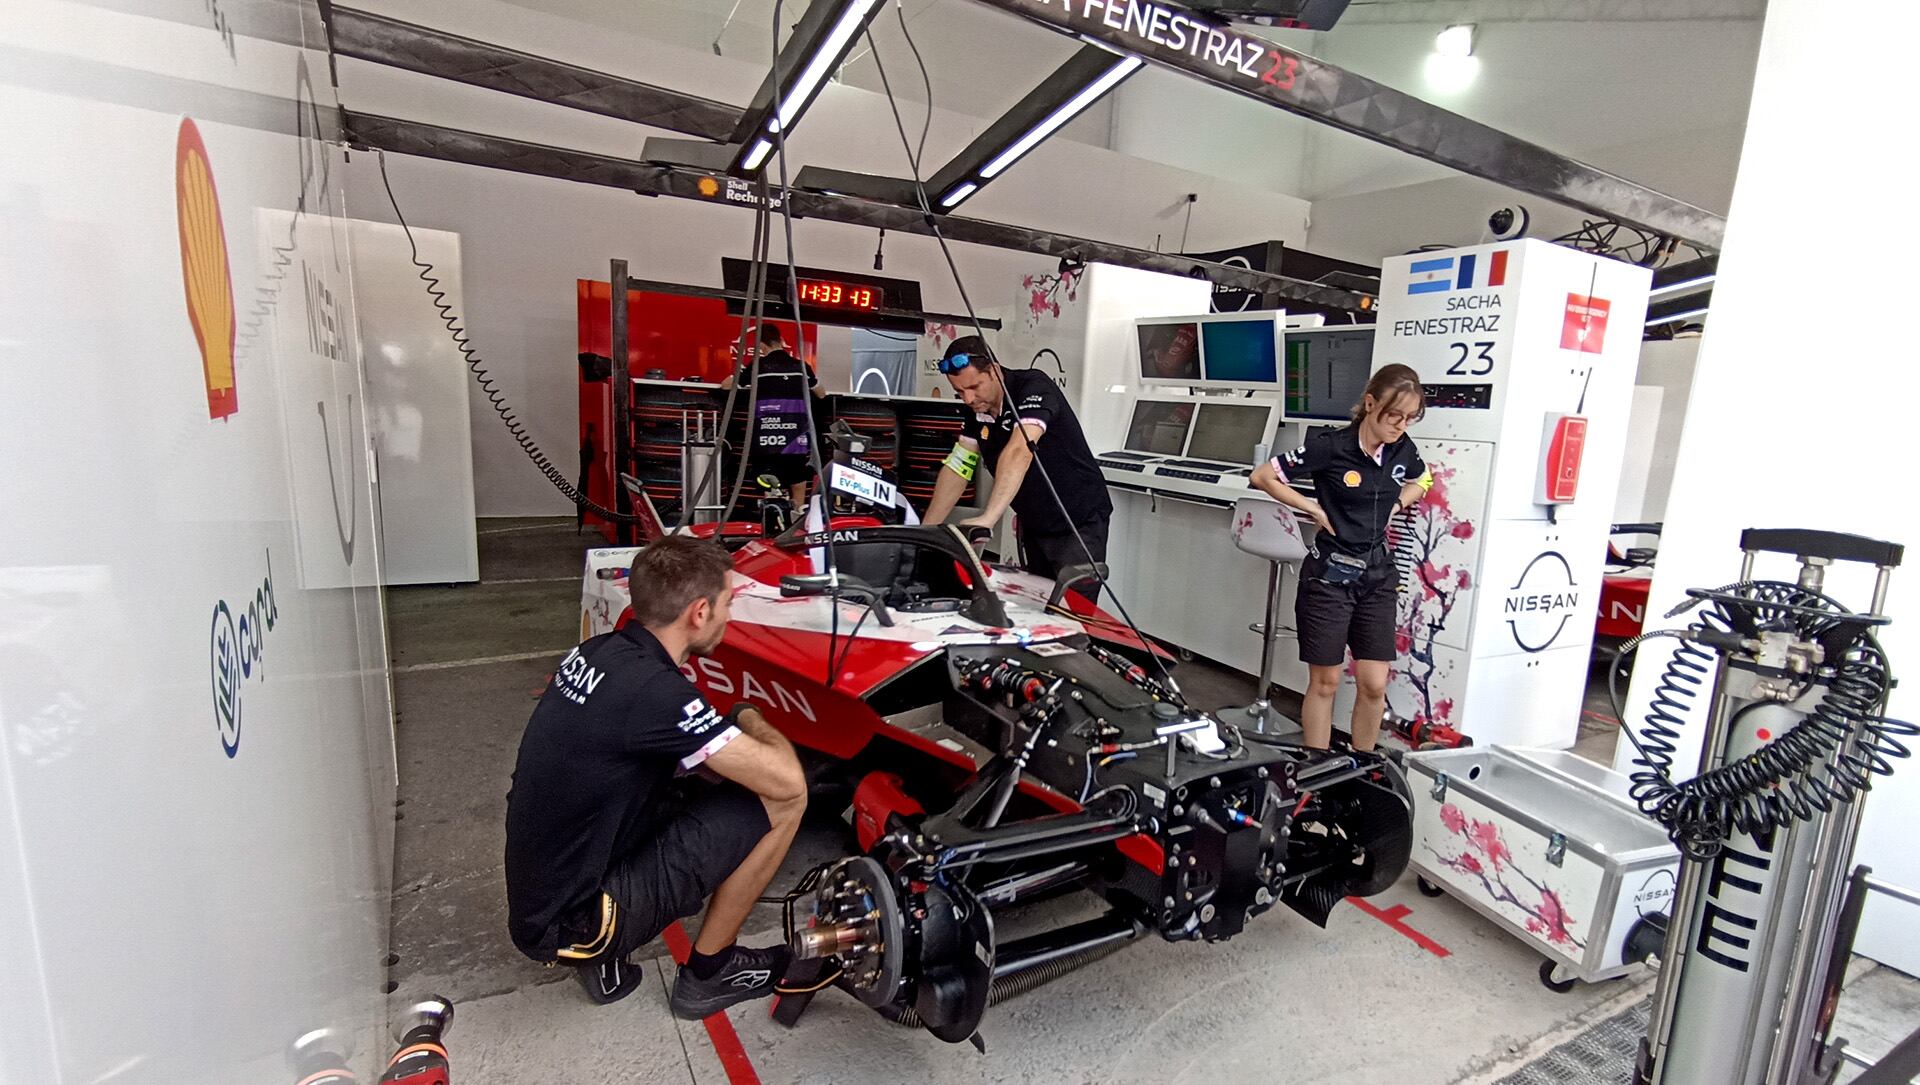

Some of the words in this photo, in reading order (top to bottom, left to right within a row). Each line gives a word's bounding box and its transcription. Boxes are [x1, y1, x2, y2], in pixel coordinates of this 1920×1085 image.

[1083, 0, 1265, 78] FENESTRAZ
[1262, 50, 1299, 91] 23
[727, 181, 748, 190] Shell
[801, 284, 841, 303] 14:33
[1446, 293, 1502, 311] SACHA
[1393, 314, 1501, 337] FENESTRAZ
[1446, 341, 1496, 376] 23
[759, 435, 787, 446] 502
[851, 457, 883, 475] NISSAN
[840, 477, 870, 495] EV-Plus
[873, 481, 890, 502] IN
[1504, 592, 1578, 614] NISSAN
